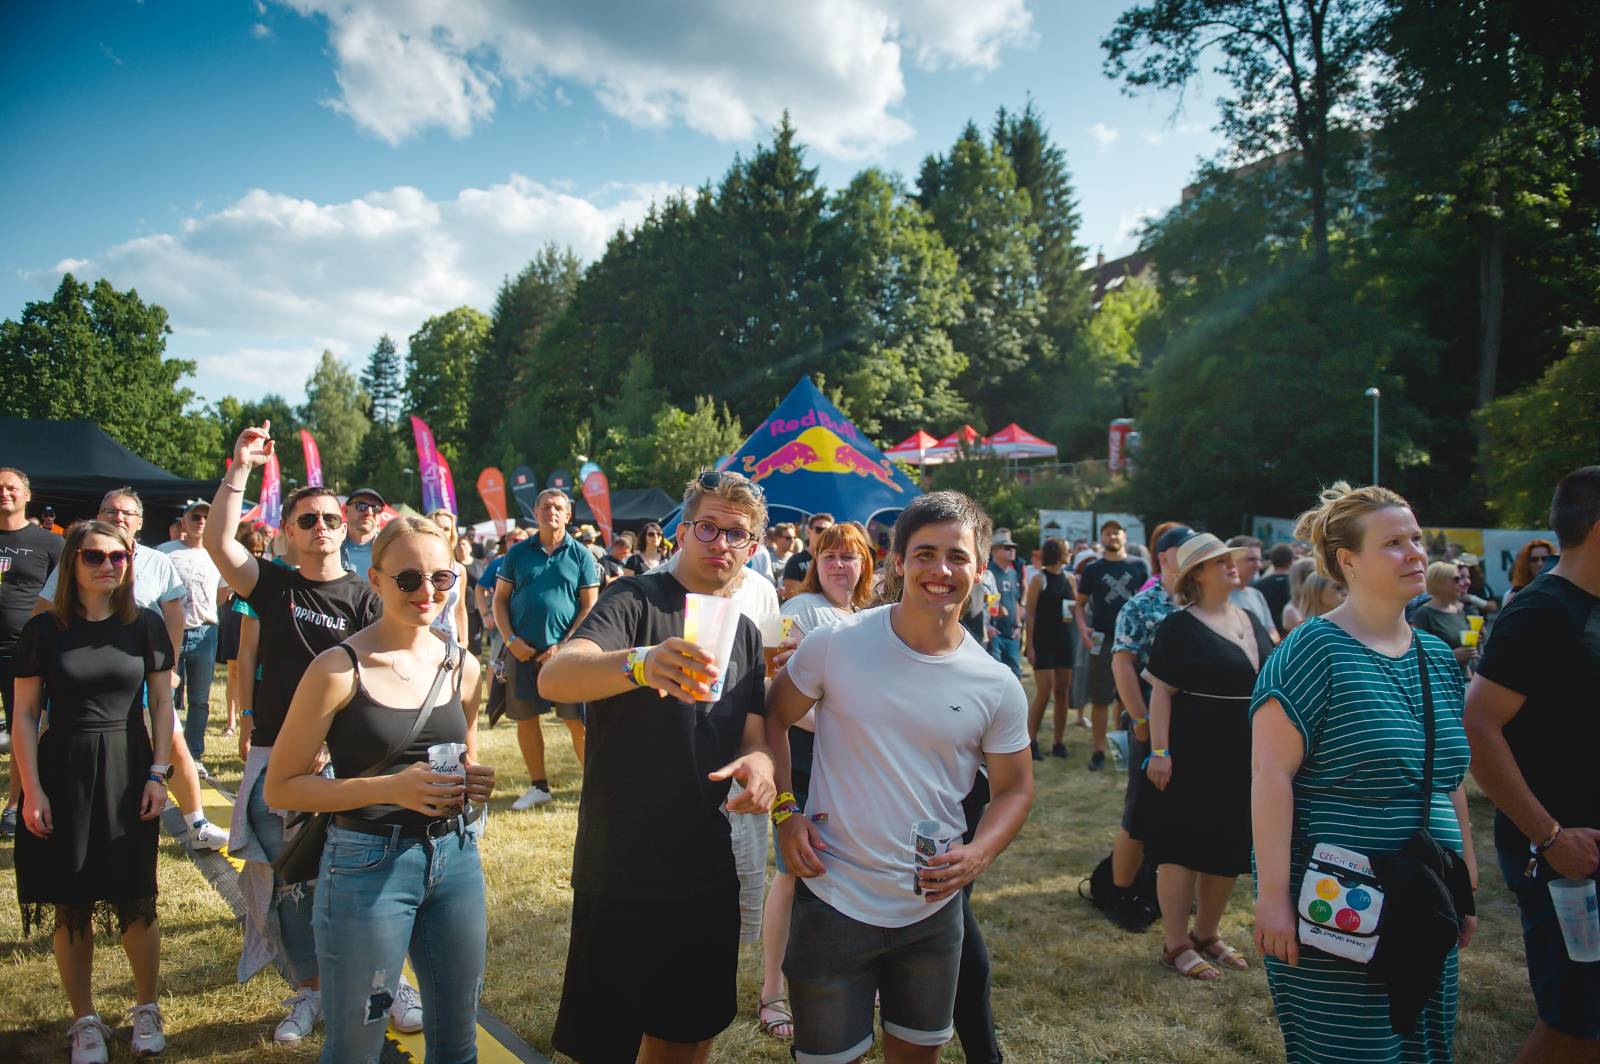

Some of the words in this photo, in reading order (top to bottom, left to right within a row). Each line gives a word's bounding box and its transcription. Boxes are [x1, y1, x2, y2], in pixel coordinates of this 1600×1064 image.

[770, 409, 816, 437] Red
[817, 410, 857, 440] Bull
[430, 760, 458, 774] Reduce
[1319, 851, 1345, 865] CZECH
[1310, 927, 1345, 942] ALPINE
[1345, 937, 1366, 948] PRO
